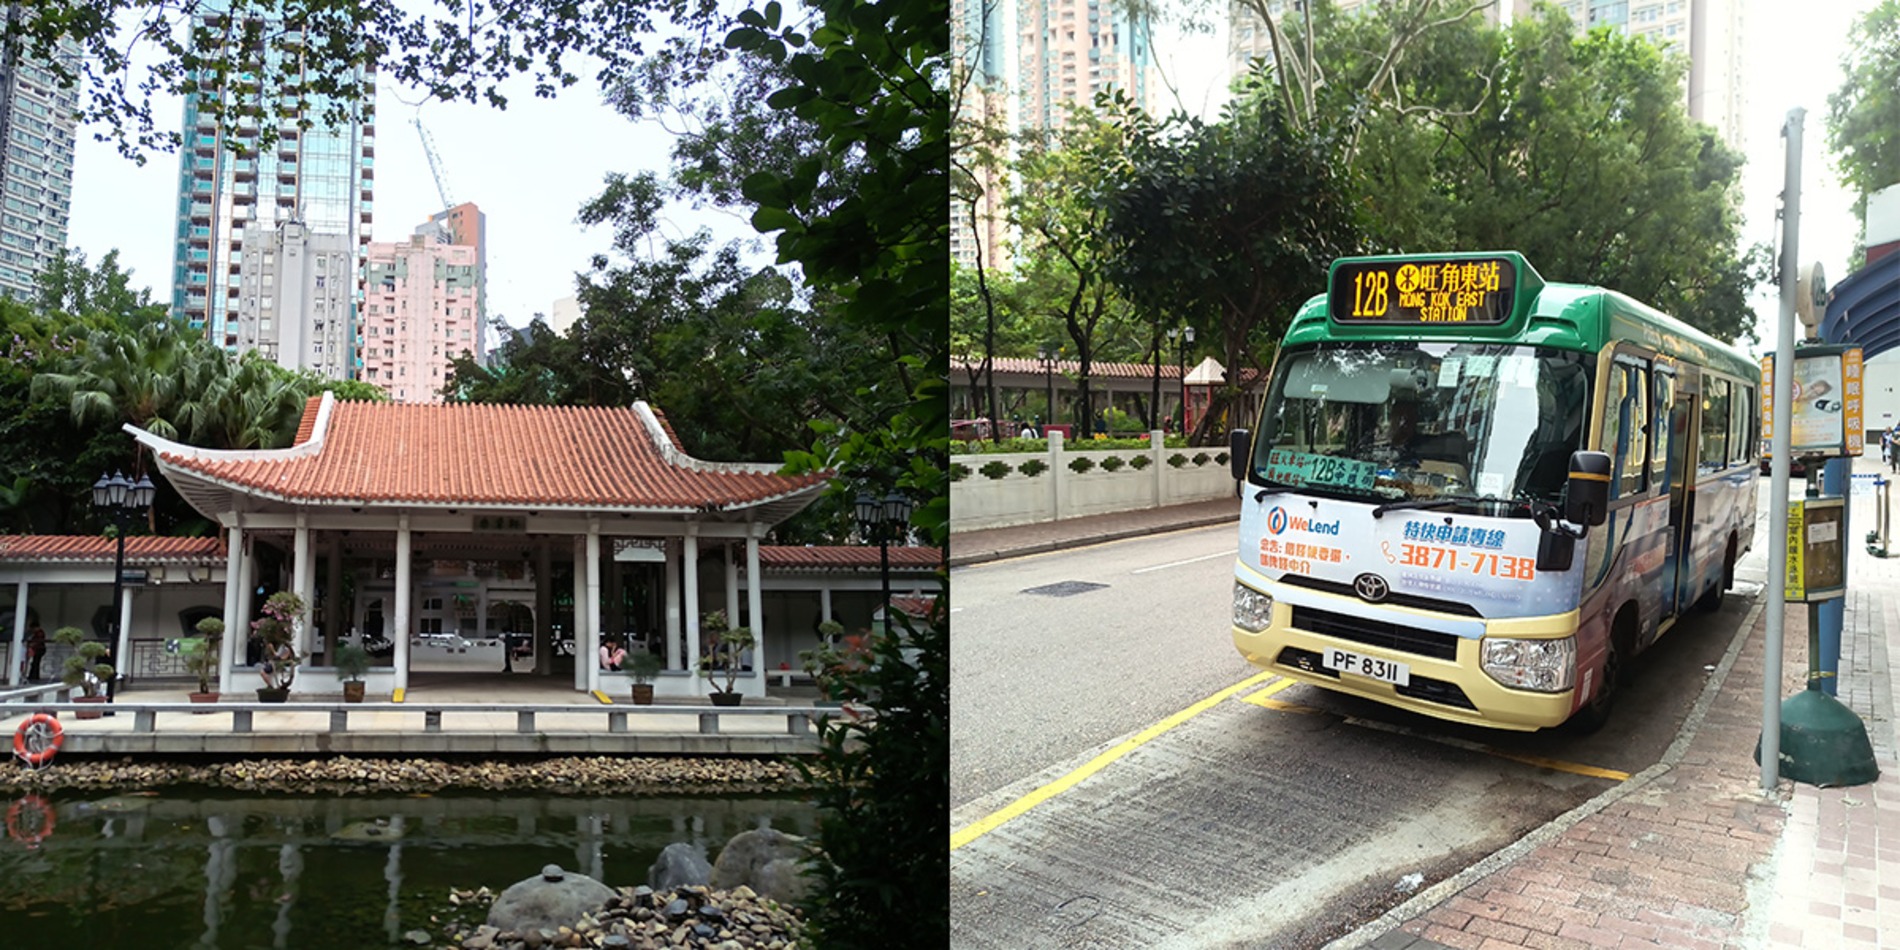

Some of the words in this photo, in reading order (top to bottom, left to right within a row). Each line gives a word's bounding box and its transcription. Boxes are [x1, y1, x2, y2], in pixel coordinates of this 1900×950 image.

[1420, 261, 1500, 292] 旺角東站
[1352, 271, 1390, 317] 12B
[1398, 292, 1426, 308] MONG
[1430, 292, 1451, 308] KOK
[1458, 291, 1486, 307] EAST
[1420, 306, 1467, 322] STATION
[1311, 457, 1337, 482] 12B
[1289, 516, 1340, 535] WeLend
[1403, 520, 1506, 549] 特快申請專線
[1400, 543, 1536, 581] 3871-7138
[1333, 651, 1357, 670] PF
[1362, 658, 1398, 682] 8311
